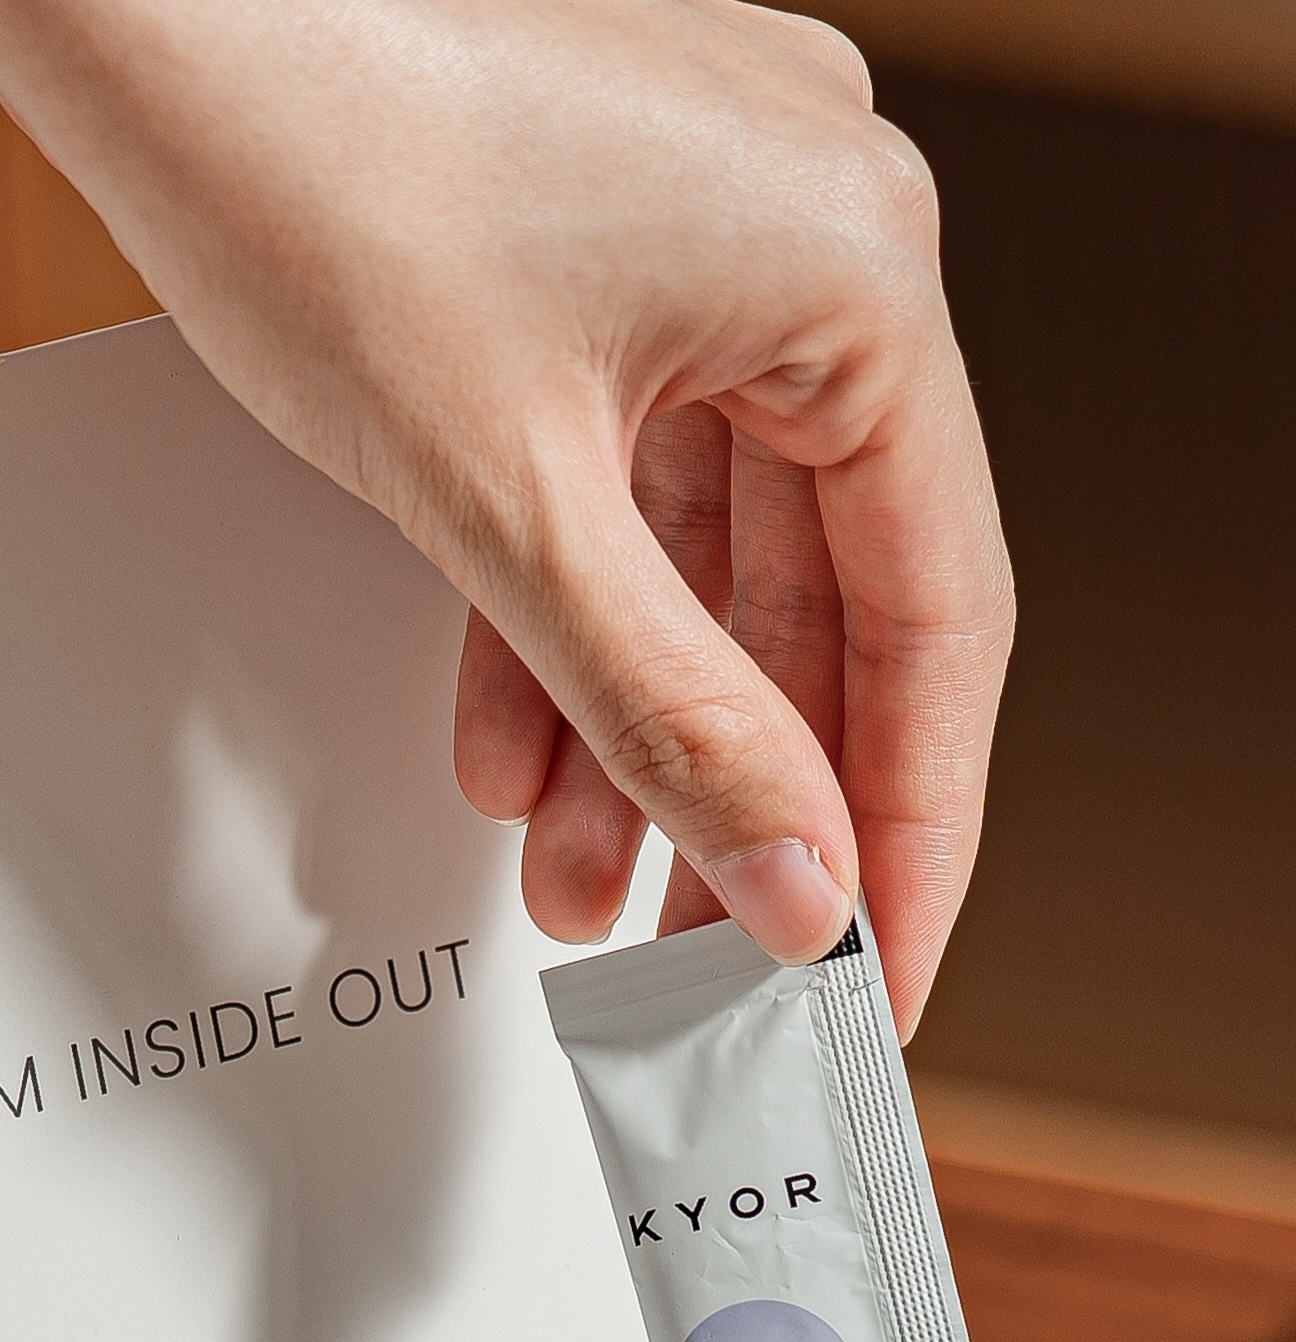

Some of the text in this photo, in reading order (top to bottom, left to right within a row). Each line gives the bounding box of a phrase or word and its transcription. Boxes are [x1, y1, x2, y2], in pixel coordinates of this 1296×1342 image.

[70, 985, 302, 1101] INSIDE
[329, 938, 473, 1028] OUT
[628, 1172, 822, 1248] KYOR
